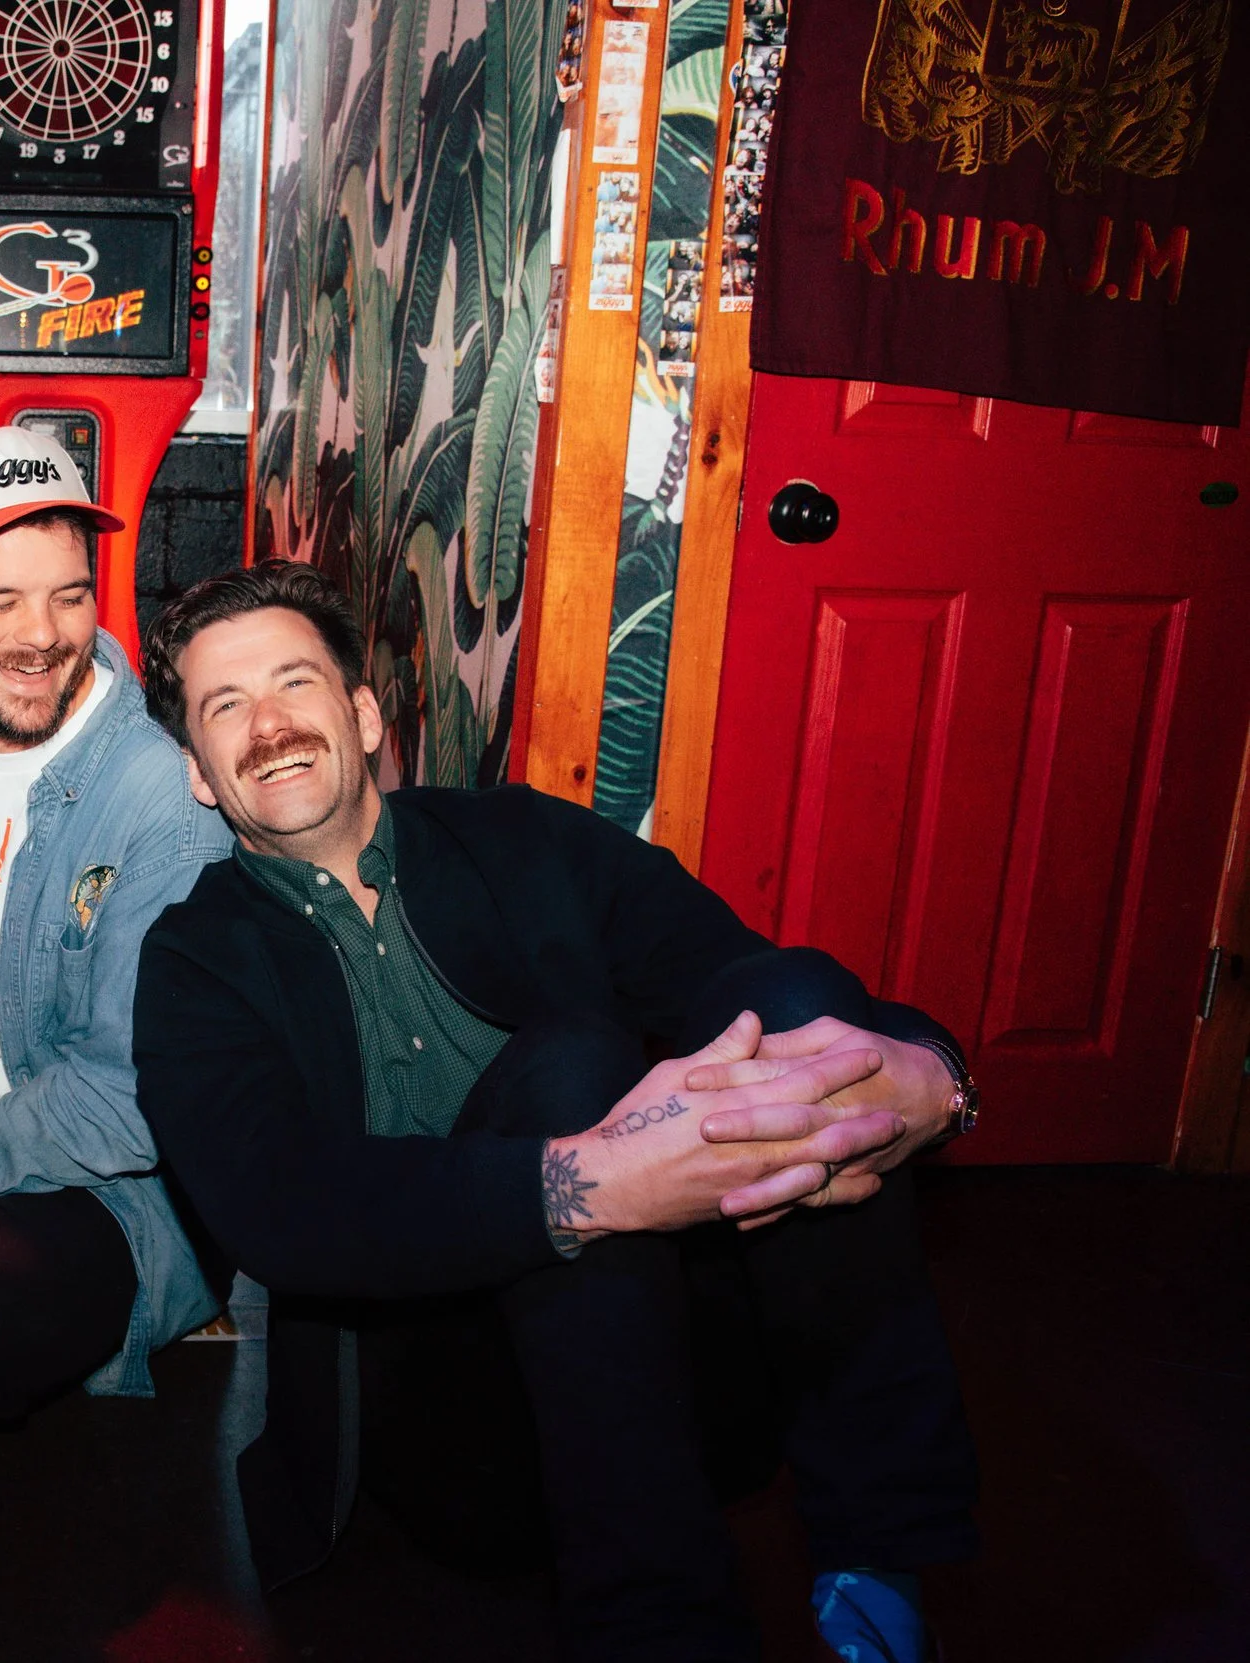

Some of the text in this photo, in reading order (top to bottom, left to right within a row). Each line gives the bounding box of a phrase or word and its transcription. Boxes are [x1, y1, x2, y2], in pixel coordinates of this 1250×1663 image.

[154, 11, 173, 26] 13
[158, 43, 170, 59] 6
[151, 77, 168, 93] 10
[136, 107, 154, 123] 15
[114, 130, 126, 146] 2
[19, 143, 37, 158] 19
[54, 148, 66, 164] 3
[83, 144, 100, 159] 17
[843, 178, 1046, 288] Rhum
[36, 289, 145, 348] FIRE
[600, 1094, 690, 1139] FOCUS
